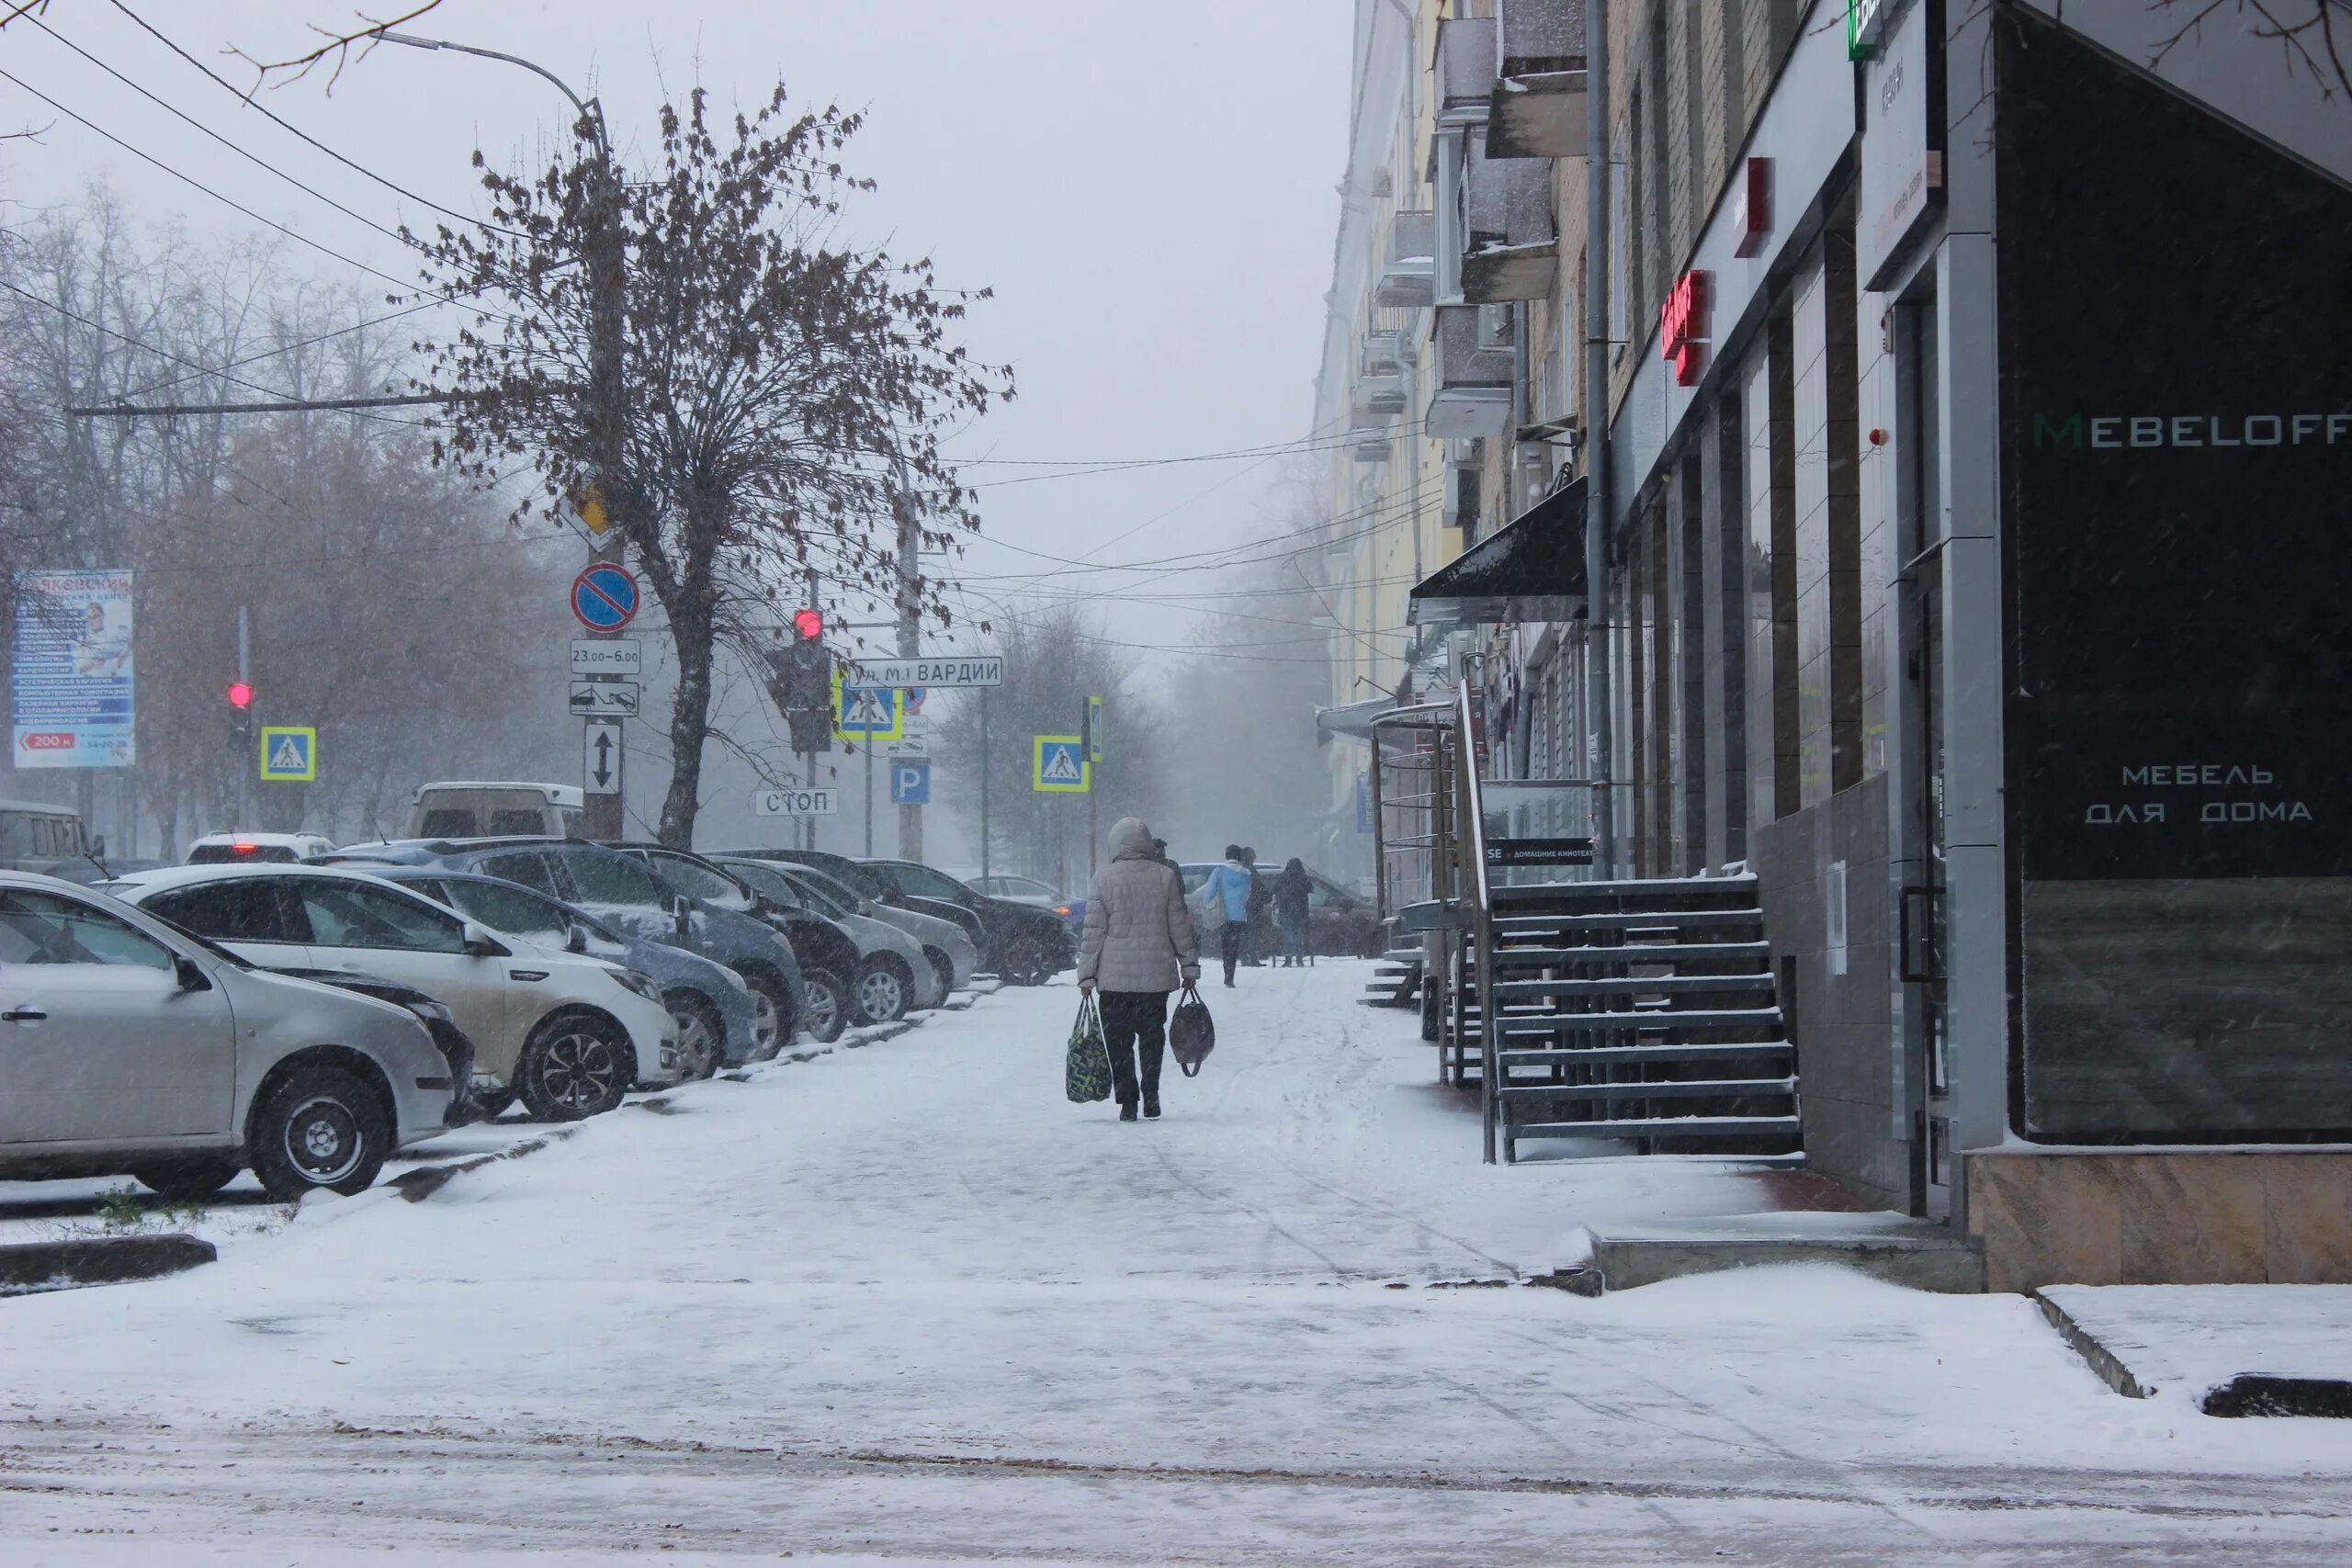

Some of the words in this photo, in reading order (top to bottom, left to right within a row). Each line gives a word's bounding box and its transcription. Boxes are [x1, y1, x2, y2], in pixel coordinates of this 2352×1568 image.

[2031, 412, 2352, 449] MEBELOFF
[34, 736, 61, 747] 200
[2121, 764, 2274, 786] МЕБЕЛЬ
[765, 791, 828, 812] СТОП
[2084, 803, 2165, 824] ДЛЯ
[2199, 801, 2313, 822] ДОМА
